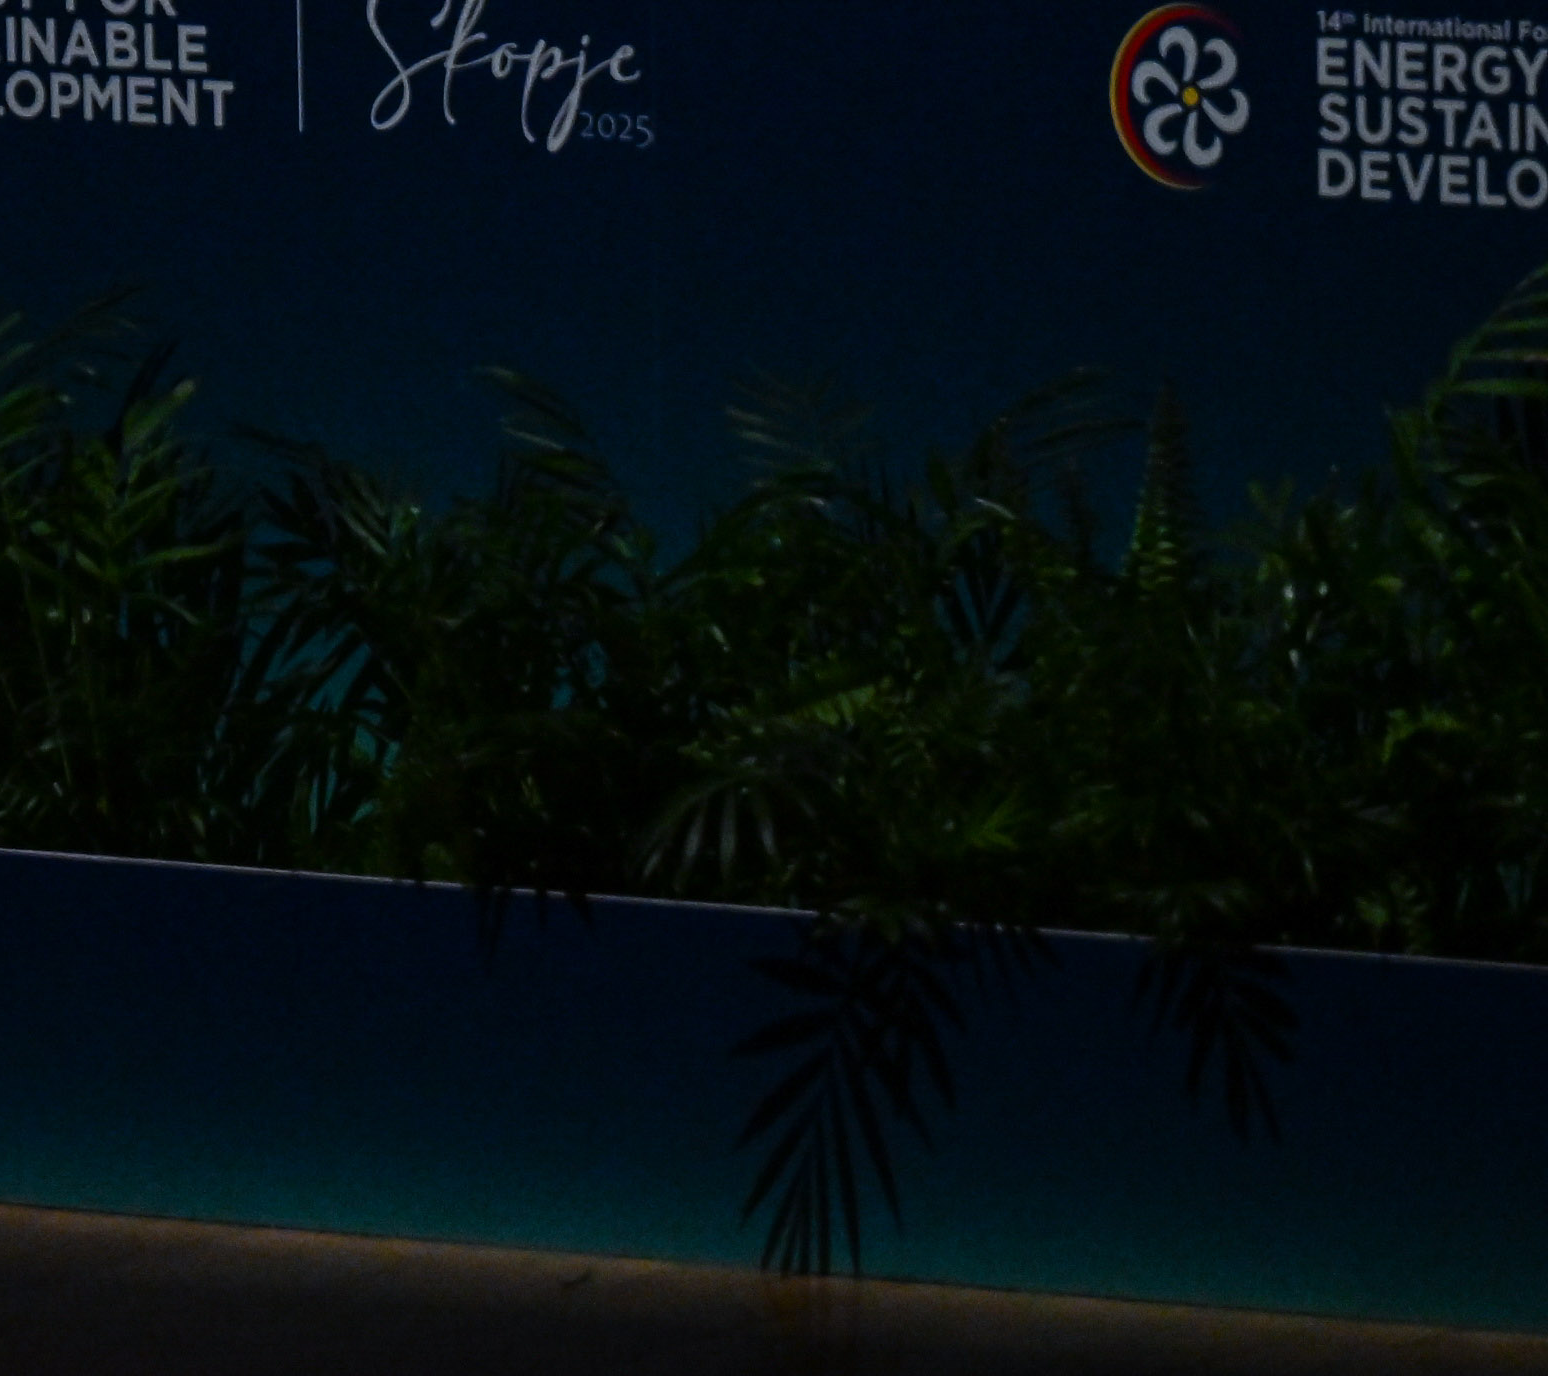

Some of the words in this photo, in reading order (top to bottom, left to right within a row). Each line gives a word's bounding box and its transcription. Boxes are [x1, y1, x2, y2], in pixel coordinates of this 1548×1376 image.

[1363, 12, 1512, 42] International
[1316, 37, 1548, 97] ENERGY
[579, 111, 655, 149] 2025
[1317, 148, 1548, 210] DEVELO
